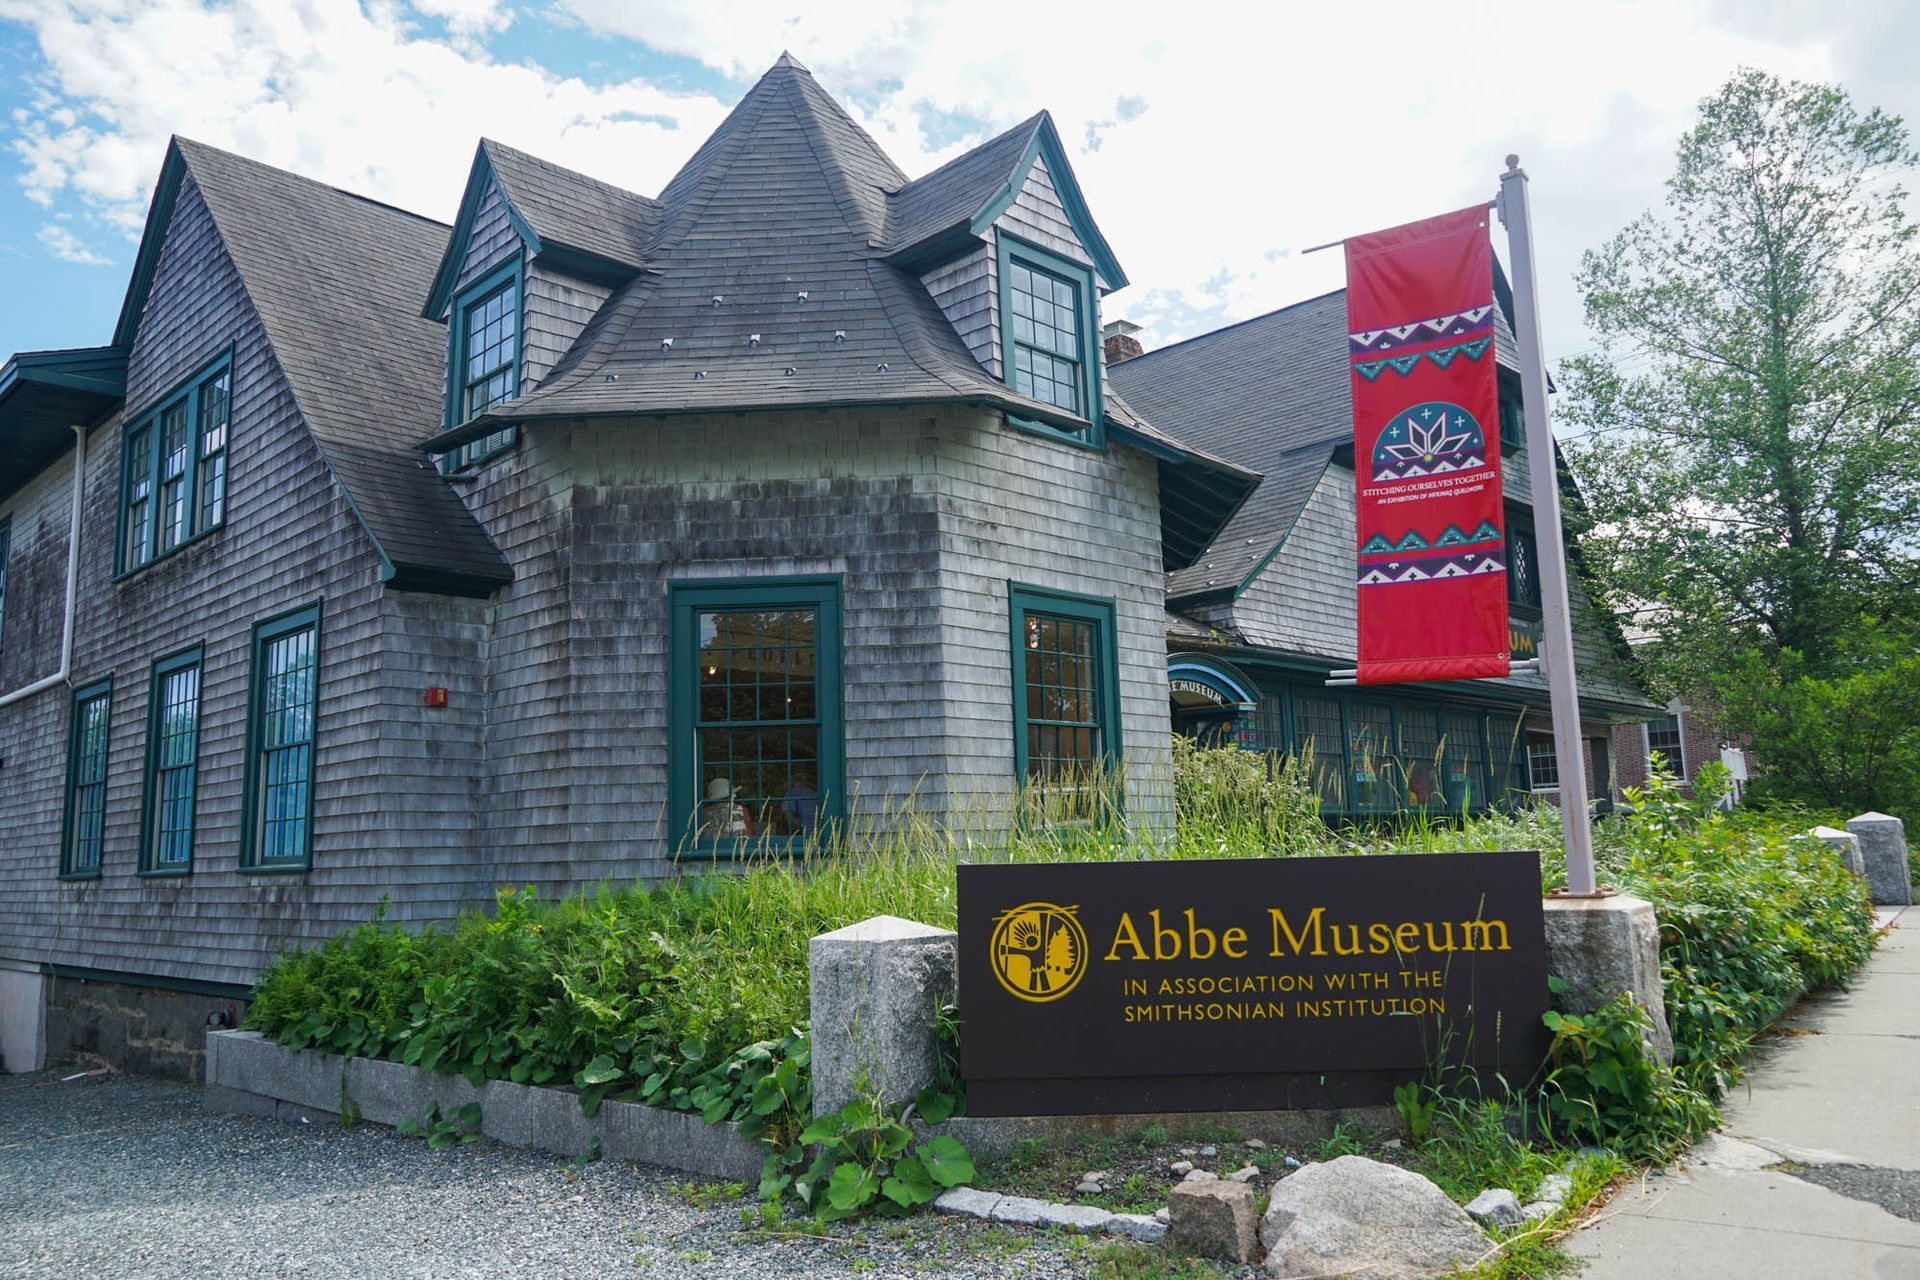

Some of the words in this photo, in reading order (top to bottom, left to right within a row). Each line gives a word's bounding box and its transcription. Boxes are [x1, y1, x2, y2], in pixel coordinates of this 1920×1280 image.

[1362, 485, 1407, 497] STITCHING
[1407, 478, 1453, 492] OURSELVES
[1454, 470, 1496, 485] TOGETHER
[1387, 493, 1419, 504] EXHIBITION
[1419, 492, 1428, 500] OF
[1180, 680, 1222, 705] MUSEUM
[1104, 908, 1248, 961] Abbe
[1267, 907, 1512, 957] Museum
[1124, 979, 1147, 995] IN
[1159, 975, 1313, 994] ASSOCIATION
[1325, 973, 1388, 990] WITH
[1399, 970, 1442, 988] THE
[1125, 1002, 1284, 1022] SMITHSONIAN
[1296, 998, 1445, 1017] INSTITUTION
